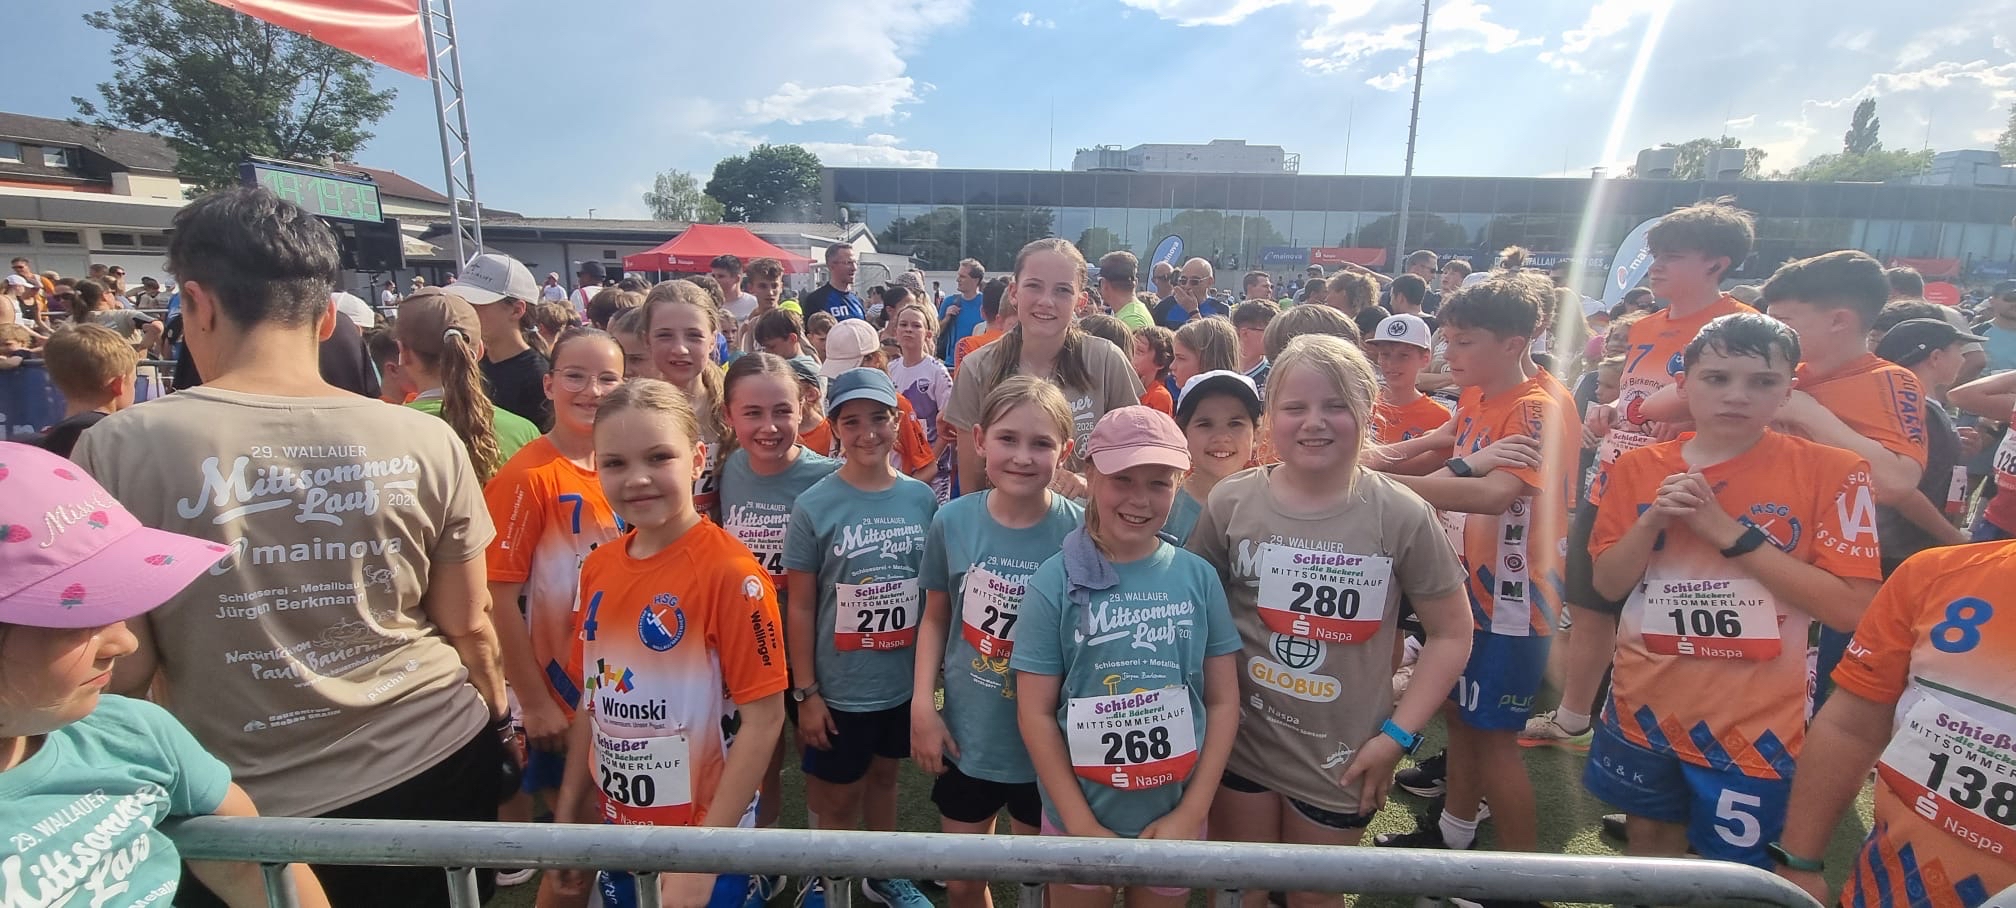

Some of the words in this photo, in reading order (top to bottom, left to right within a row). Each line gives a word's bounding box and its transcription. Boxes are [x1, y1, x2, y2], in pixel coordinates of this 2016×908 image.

[251, 446, 278, 459] 29.
[282, 445, 368, 459] WALLAUER
[176, 453, 420, 519] Mittsommer
[294, 480, 380, 526] Lauf
[558, 492, 584, 535] 7
[755, 501, 787, 513] WALLAUER
[1750, 502, 1790, 517] HSG
[873, 516, 906, 525] WALLAUER
[738, 529, 782, 539] Schießer
[833, 523, 924, 557] Mittsommer
[1288, 536, 1345, 553] WALLAUER
[252, 537, 402, 565] mainova
[879, 536, 913, 560] Lauf
[751, 552, 784, 575] 74
[986, 555, 999, 566] 29.
[1000, 557, 1040, 571] WALLAUER
[1292, 553, 1363, 567] Schießer
[300, 581, 361, 594] Metallbau
[988, 578, 1026, 596] Schieß
[1271, 567, 1384, 587] MITTSOMMERLAUF
[1663, 580, 1730, 594] Schießer
[653, 592, 679, 608] HSG
[854, 581, 904, 599] Schießer
[1109, 593, 1124, 603] 29.
[1124, 592, 1169, 602] WALLAUER
[1289, 581, 1361, 620] 280
[275, 591, 365, 611] Berkmann
[840, 594, 918, 608] MITTSOMMERLAUF
[1648, 597, 1765, 607] MITTSOMMERLAUF
[857, 606, 907, 633] 270
[980, 604, 1018, 640] 27
[1074, 599, 1196, 644] Mittsommer
[1668, 608, 1742, 638] 106
[1929, 596, 1994, 653] 8
[750, 609, 772, 667] Wellinger
[878, 639, 905, 649] Naspa
[1131, 619, 1176, 652] Lauf
[1315, 626, 1353, 643] Naspa
[1701, 646, 1743, 659] Naspa
[1094, 658, 1141, 671] Schlosserei
[1149, 657, 1181, 670] Metallba
[1251, 662, 1337, 698] GLOBUS
[602, 696, 667, 721] Wronski
[1094, 691, 1161, 715] Schießer
[1128, 706, 1165, 718] Bäckerei
[1076, 707, 1186, 730] MITTSOMMERLAUF
[1267, 704, 1301, 725] Naspa
[1101, 725, 1172, 765] 268
[1909, 720, 2016, 780] MITTSOMMER
[601, 754, 681, 771] SOMMERLAUF
[600, 763, 656, 807] 230
[1135, 771, 1173, 788] Naspa
[1633, 772, 1645, 784] K
[1926, 751, 2016, 827] 138
[9, 831, 43, 853] 29.
[32, 787, 112, 838] WALLAUER
[1713, 788, 1761, 848] 5
[1943, 814, 2004, 854] Naspa
